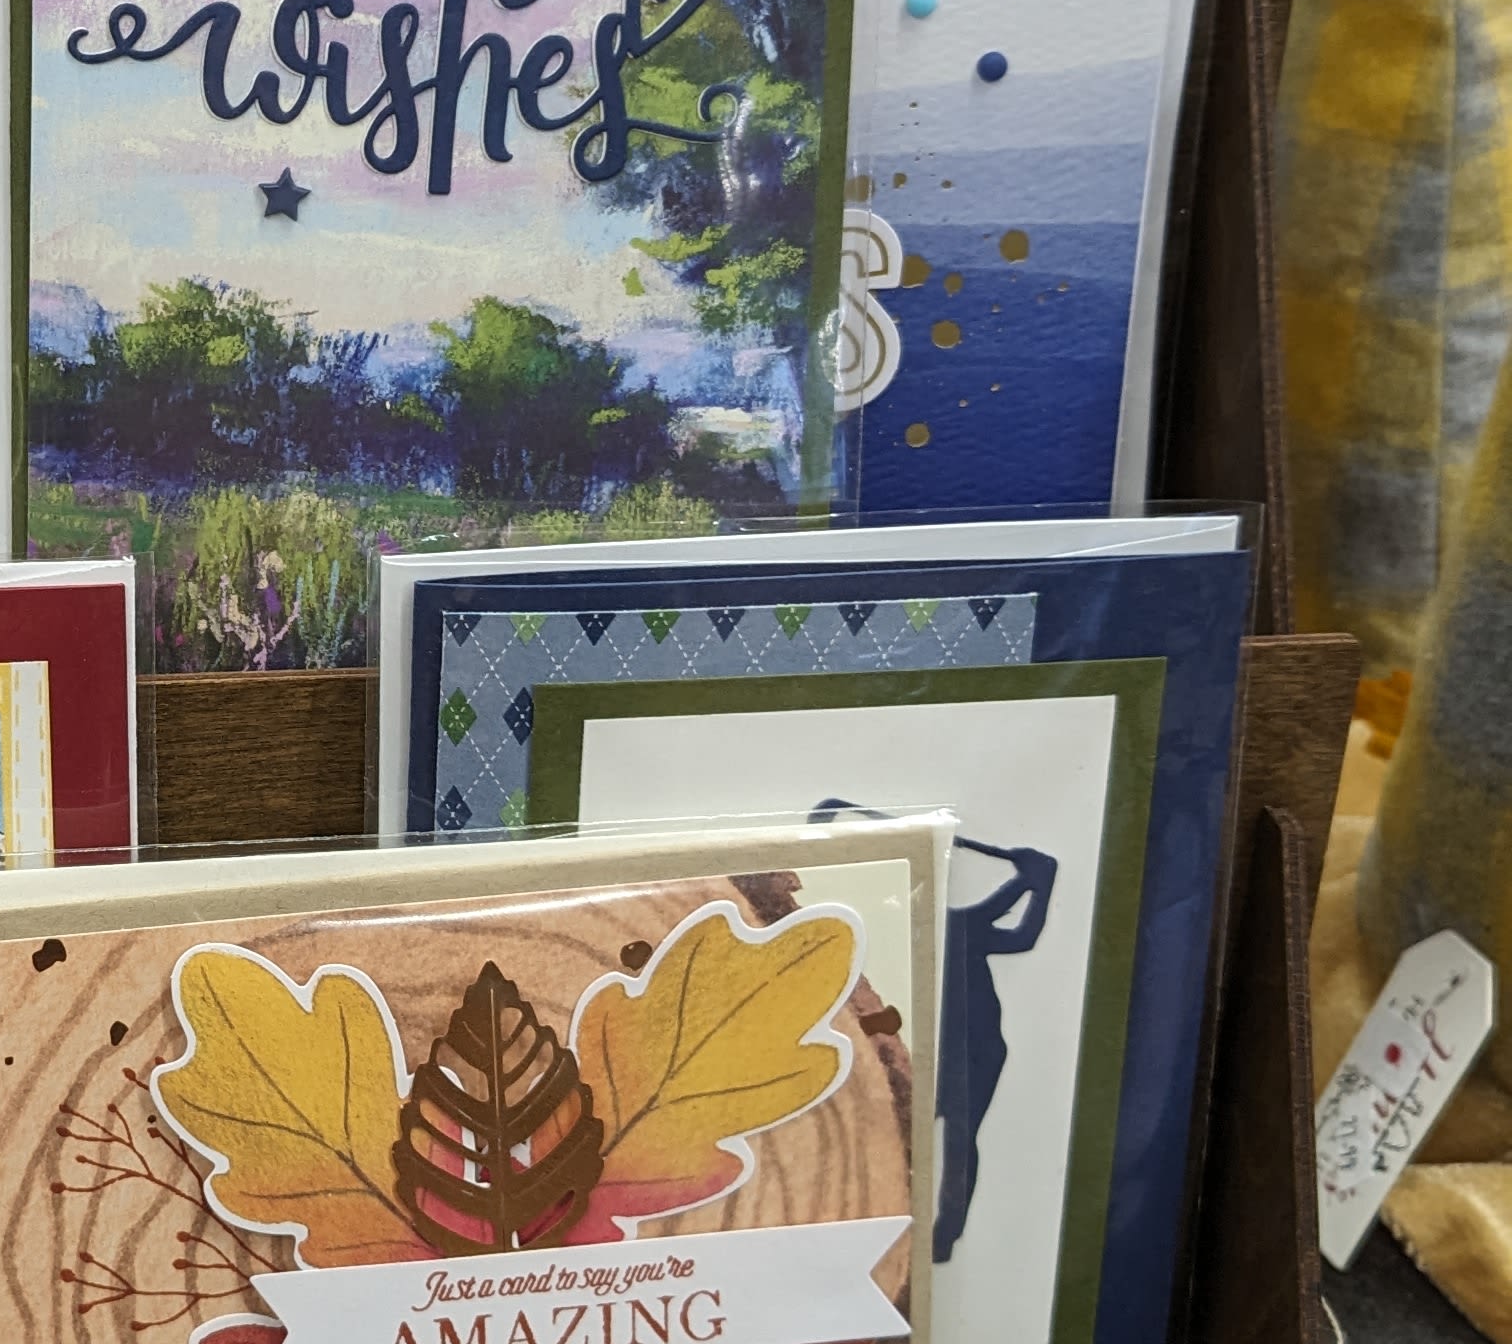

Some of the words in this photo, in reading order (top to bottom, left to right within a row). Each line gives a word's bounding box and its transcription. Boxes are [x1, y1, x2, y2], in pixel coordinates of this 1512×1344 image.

[411, 1270, 476, 1312] Just
[477, 1277, 495, 1298] a
[498, 1263, 555, 1297] card
[555, 1266, 577, 1291] to
[577, 1264, 618, 1297] say
[614, 1255, 695, 1295] you're
